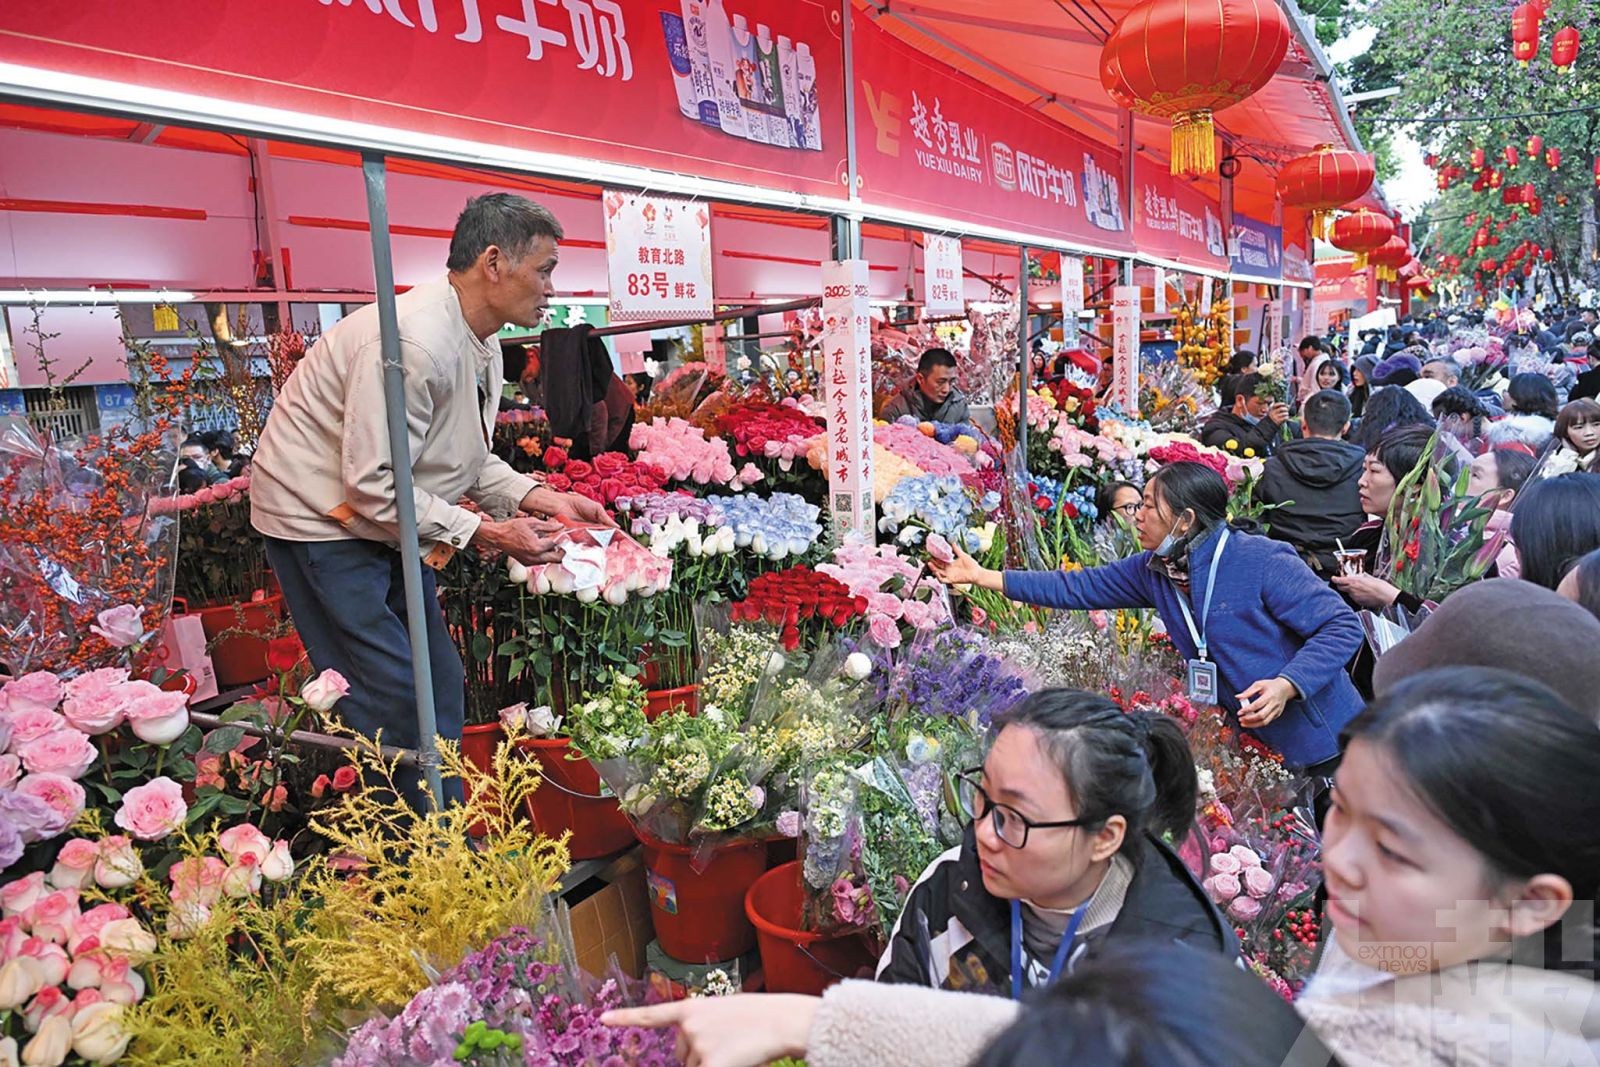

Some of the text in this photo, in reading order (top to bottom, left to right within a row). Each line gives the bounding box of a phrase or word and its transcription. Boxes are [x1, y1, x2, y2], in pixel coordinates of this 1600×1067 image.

[909, 90, 980, 164] 越秀乳业
[953, 162, 982, 184] DAIRY
[1016, 150, 1077, 207] 风行牛奶
[638, 246, 685, 266] 教育北路
[628, 272, 697, 299] 83号 鲜花
[824, 285, 851, 298] 2025
[932, 284, 949, 302] 82号
[104, 393, 121, 407] 87
